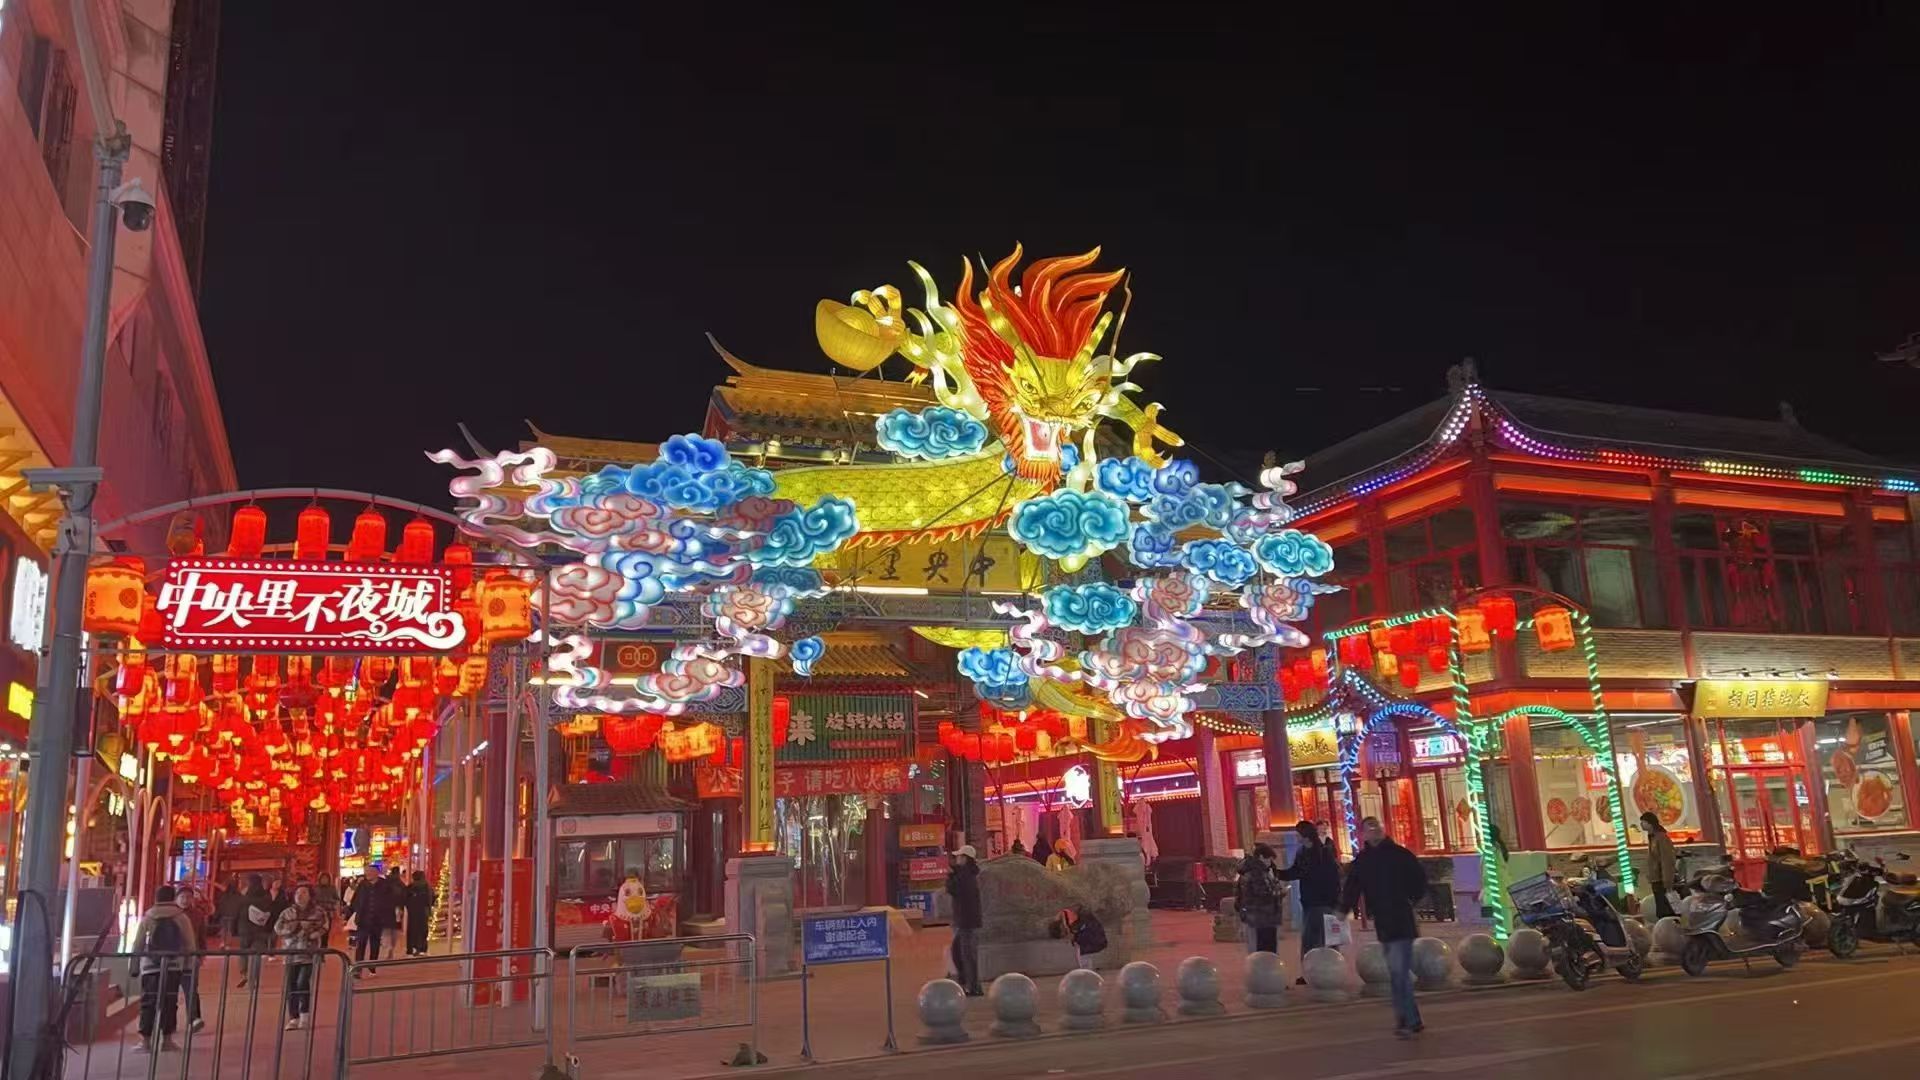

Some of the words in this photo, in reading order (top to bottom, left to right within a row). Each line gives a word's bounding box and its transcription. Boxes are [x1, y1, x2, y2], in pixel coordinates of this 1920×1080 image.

[878, 548, 996, 588] 中央里
[156, 572, 436, 633] 中央里不夜城
[826, 711, 906, 731] 旋转火锅
[815, 917, 877, 931] 车辆禁止入内
[825, 929, 868, 943] 谢谢配合
